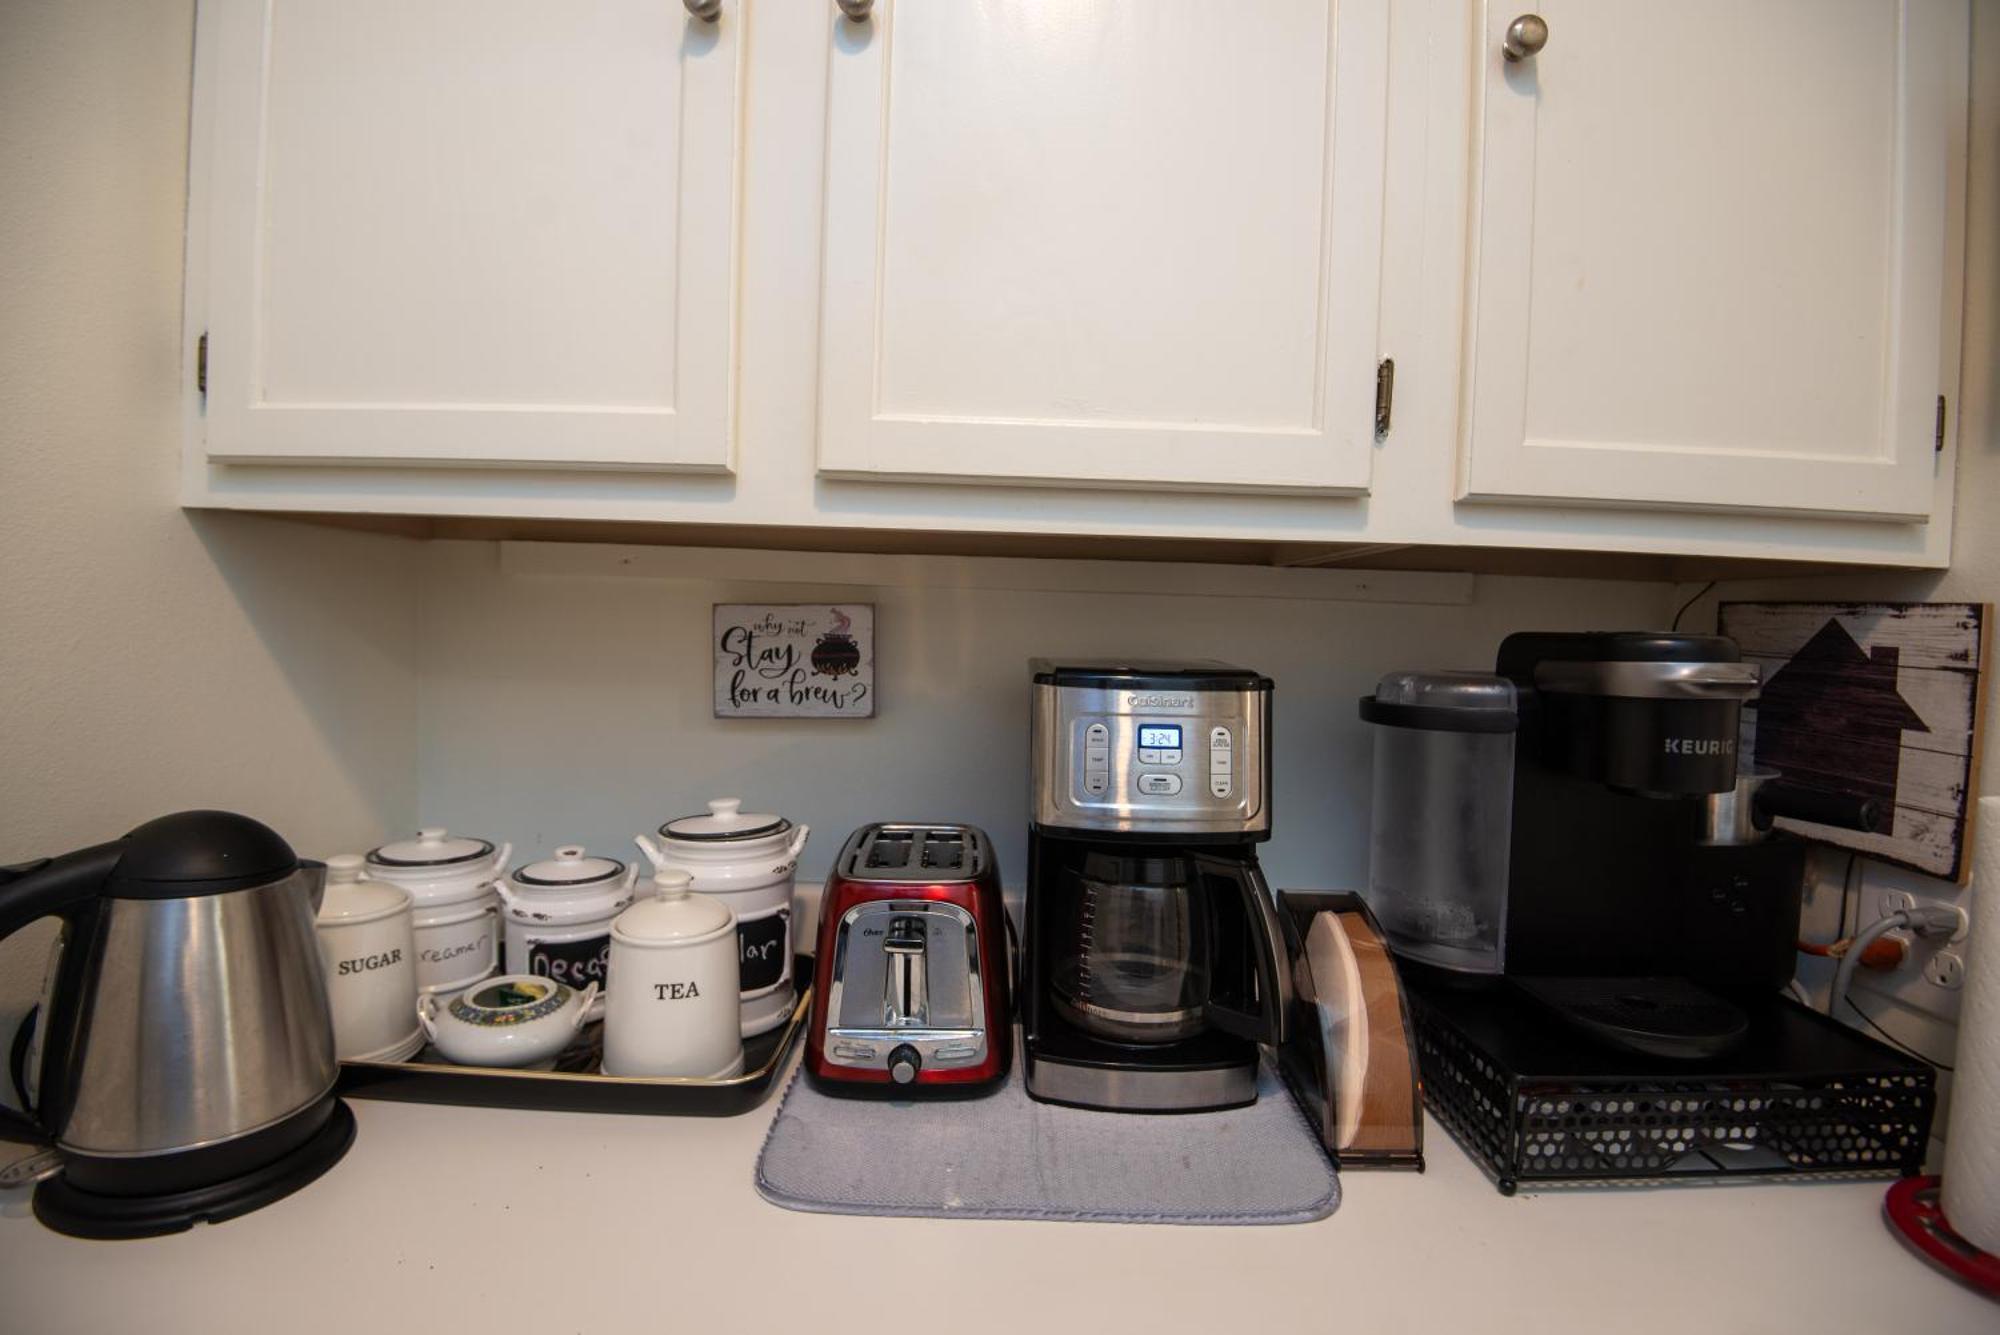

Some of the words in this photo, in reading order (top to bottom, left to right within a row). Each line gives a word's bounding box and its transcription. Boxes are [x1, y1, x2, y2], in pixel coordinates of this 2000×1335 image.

[753, 612, 783, 637] why
[720, 626, 801, 679] Stay
[728, 669, 762, 708] for
[766, 687, 780, 704] a
[782, 668, 867, 709] brew?
[1127, 694, 1194, 708] Cuisinart
[1149, 732, 1171, 745] 3:24
[338, 948, 403, 976] SUGAR
[420, 935, 490, 963] reamer
[739, 932, 778, 964] lar
[654, 981, 700, 1000] TEA
